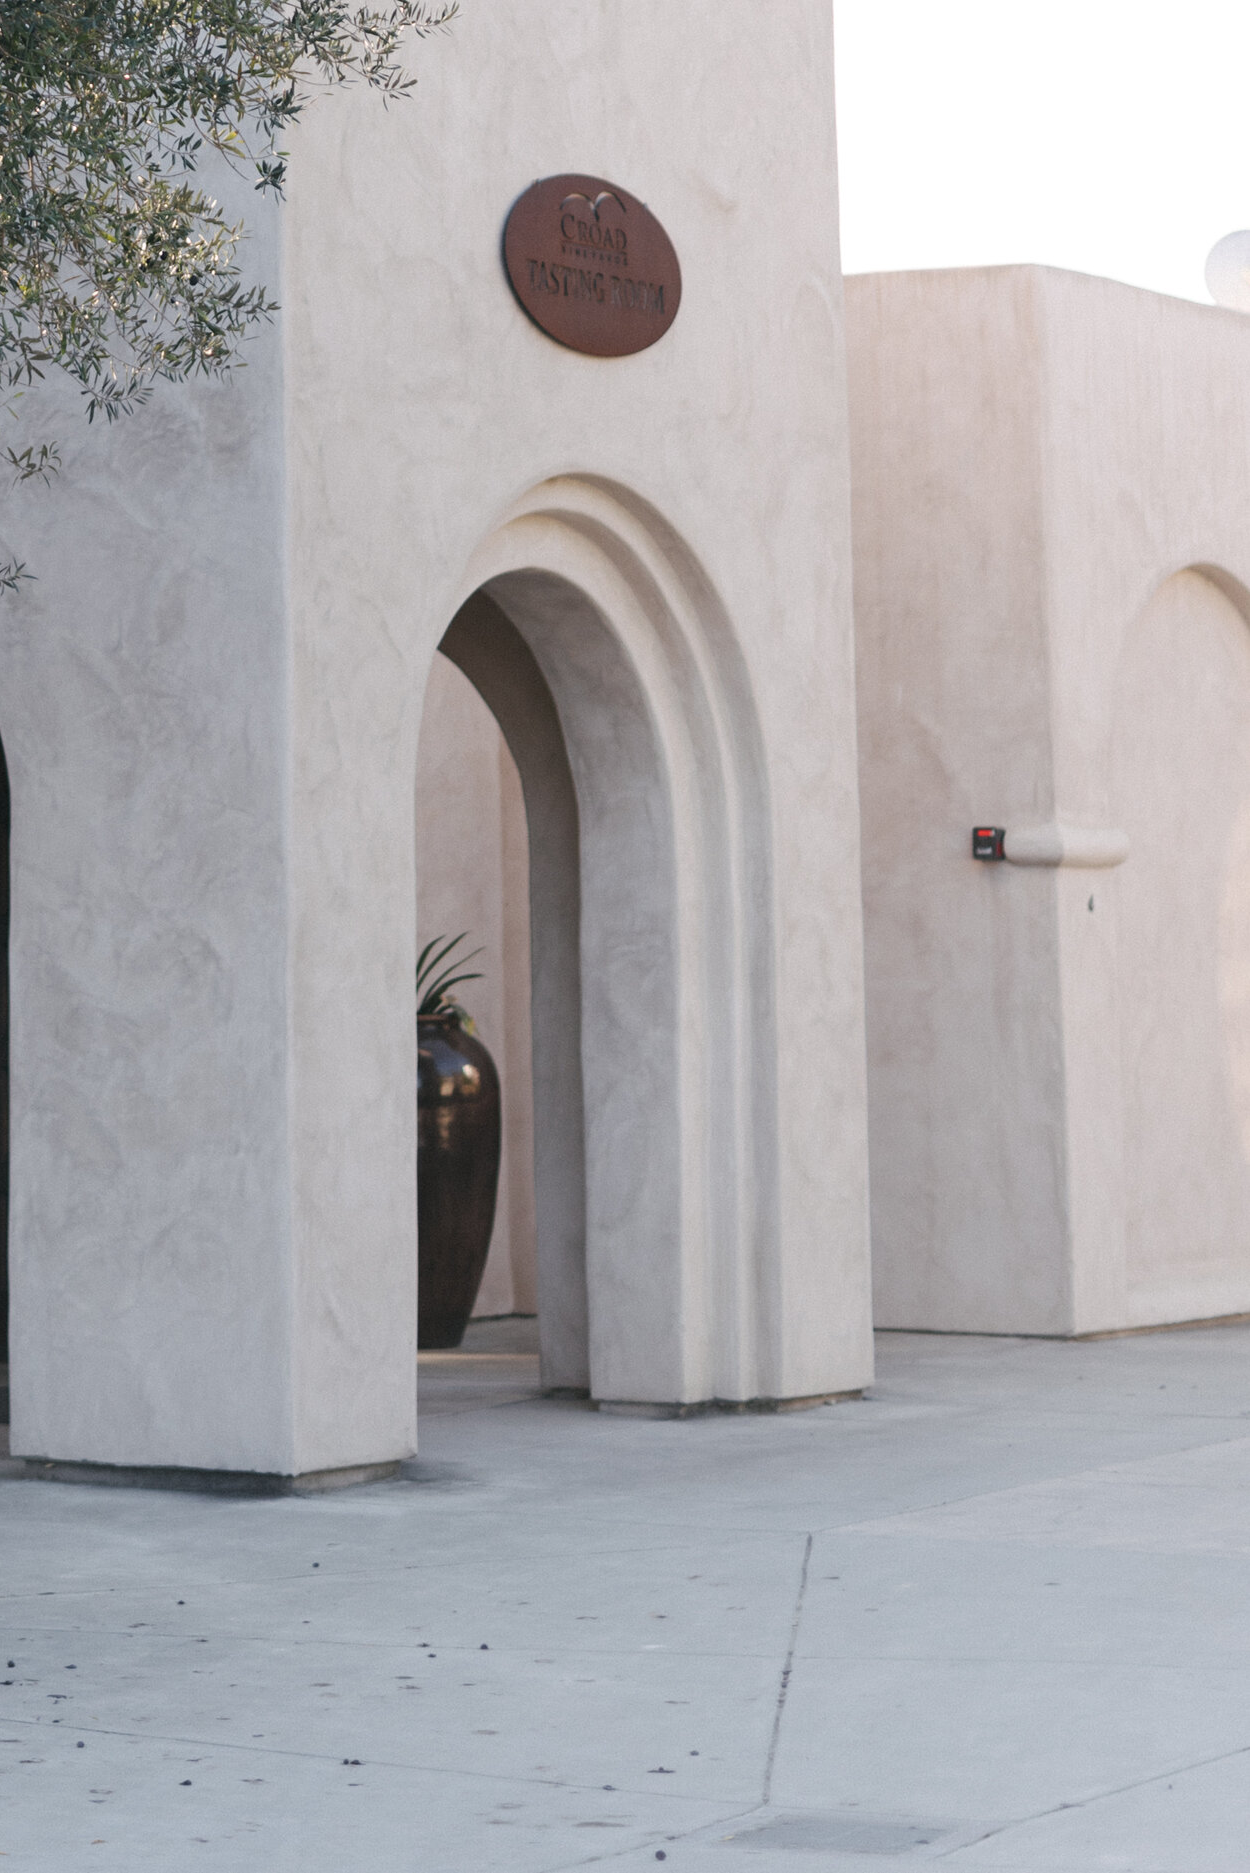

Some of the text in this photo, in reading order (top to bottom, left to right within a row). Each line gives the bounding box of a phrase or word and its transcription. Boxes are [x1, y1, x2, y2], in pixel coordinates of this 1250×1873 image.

[561, 213, 628, 250] CROAD
[527, 258, 665, 315] TASTING ROOM
